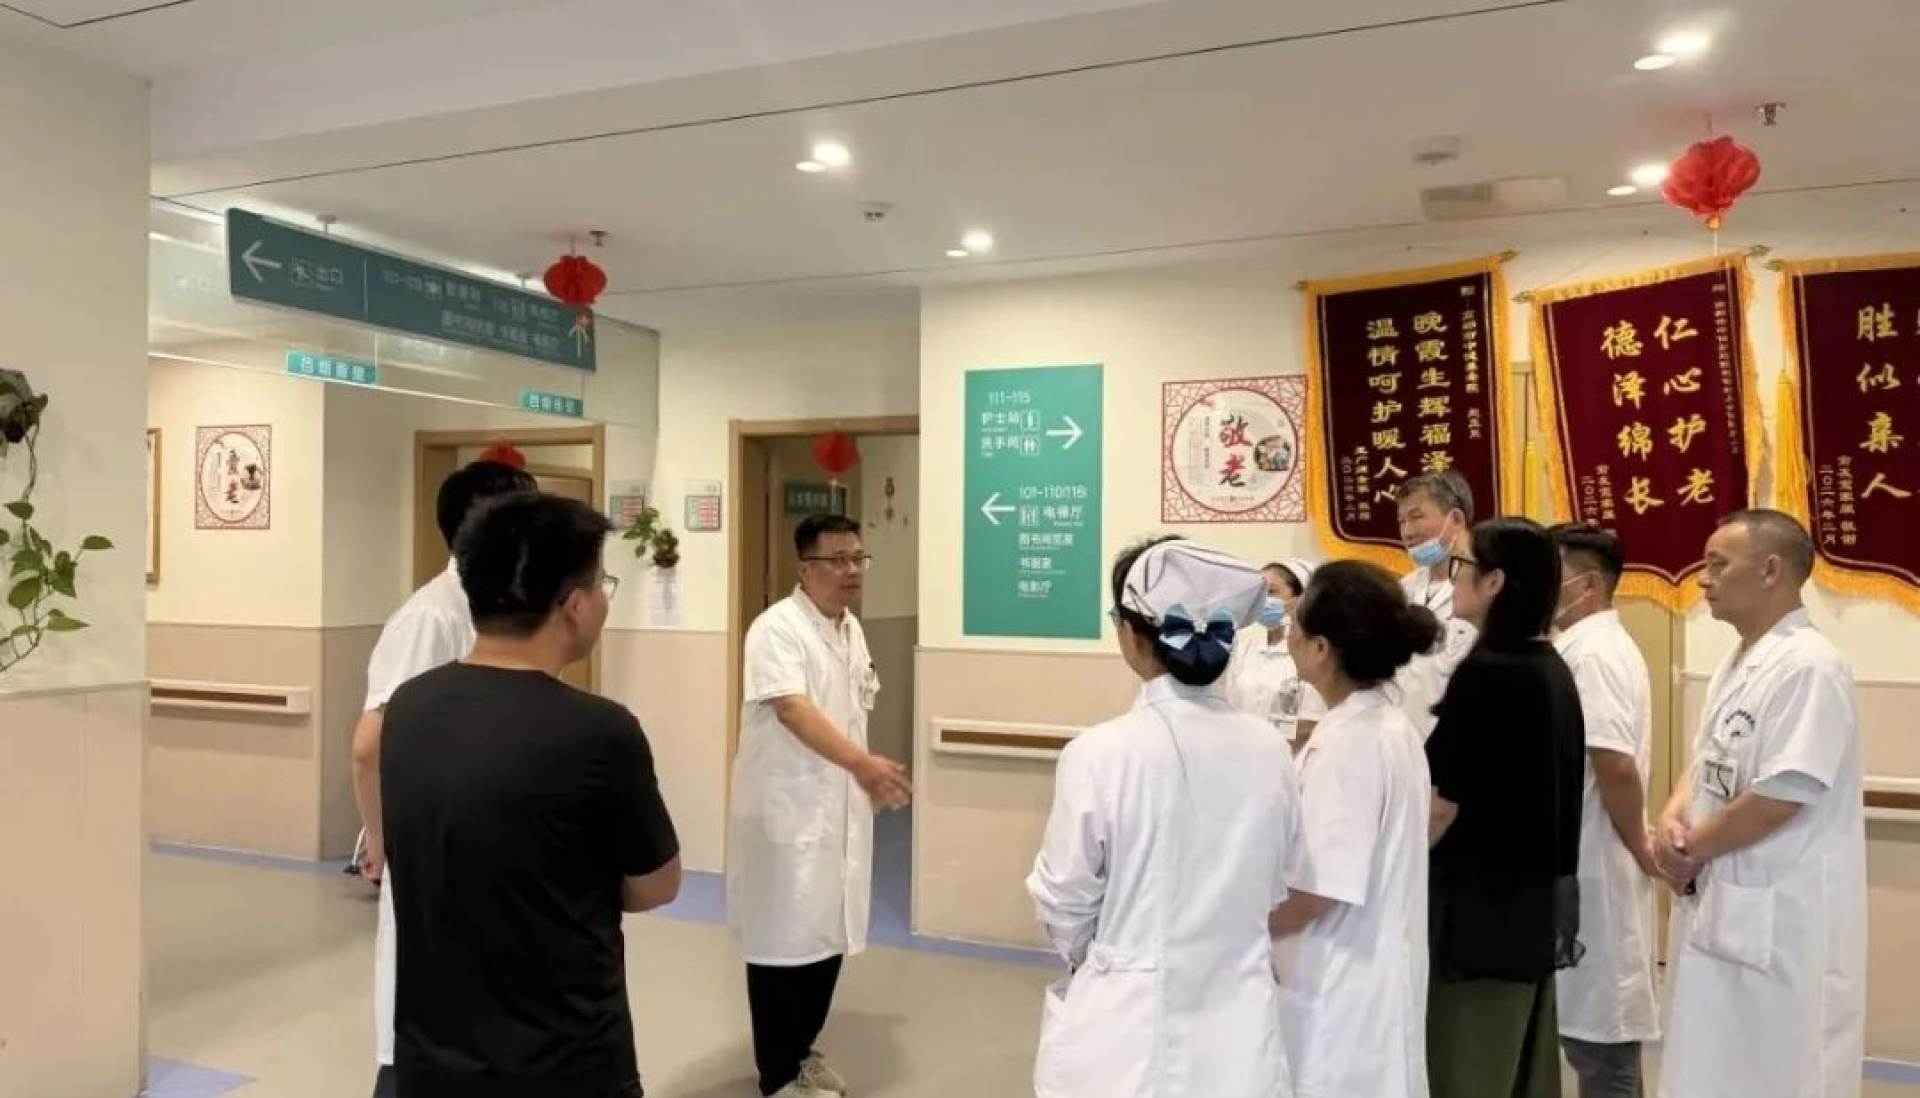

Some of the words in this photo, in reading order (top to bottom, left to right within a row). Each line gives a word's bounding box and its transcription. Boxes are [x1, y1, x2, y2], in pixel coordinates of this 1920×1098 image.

[1218, 413, 1253, 487] 敬老
[1600, 320, 1665, 515] 德泽绵长
[1654, 315, 1715, 505] 仁心护老
